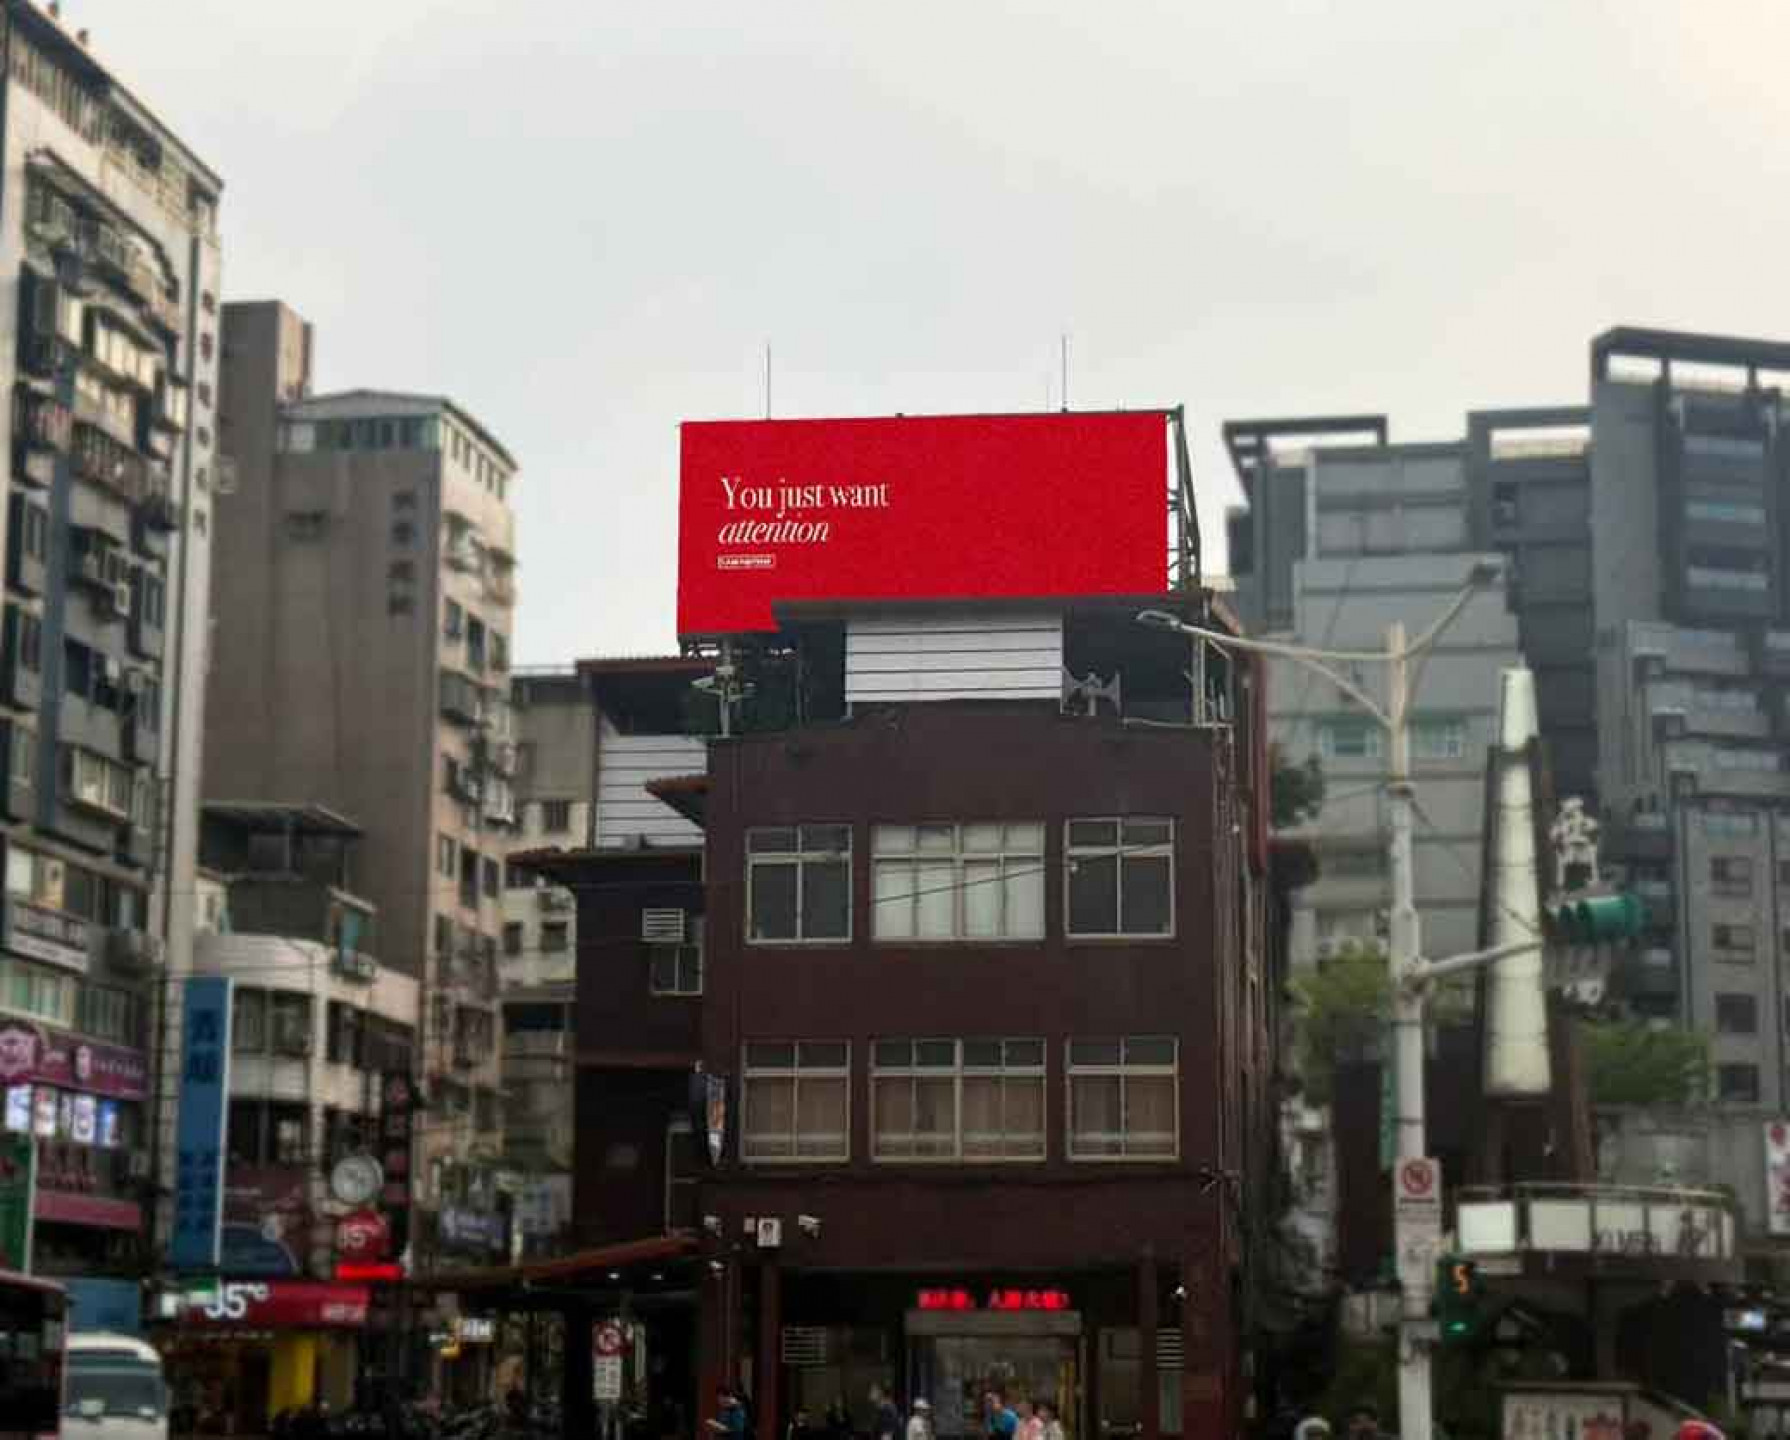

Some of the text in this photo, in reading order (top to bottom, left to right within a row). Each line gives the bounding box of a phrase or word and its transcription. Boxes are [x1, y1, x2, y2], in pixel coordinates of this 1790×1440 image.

[721, 476, 890, 519] You just want
[718, 512, 830, 546] attention
